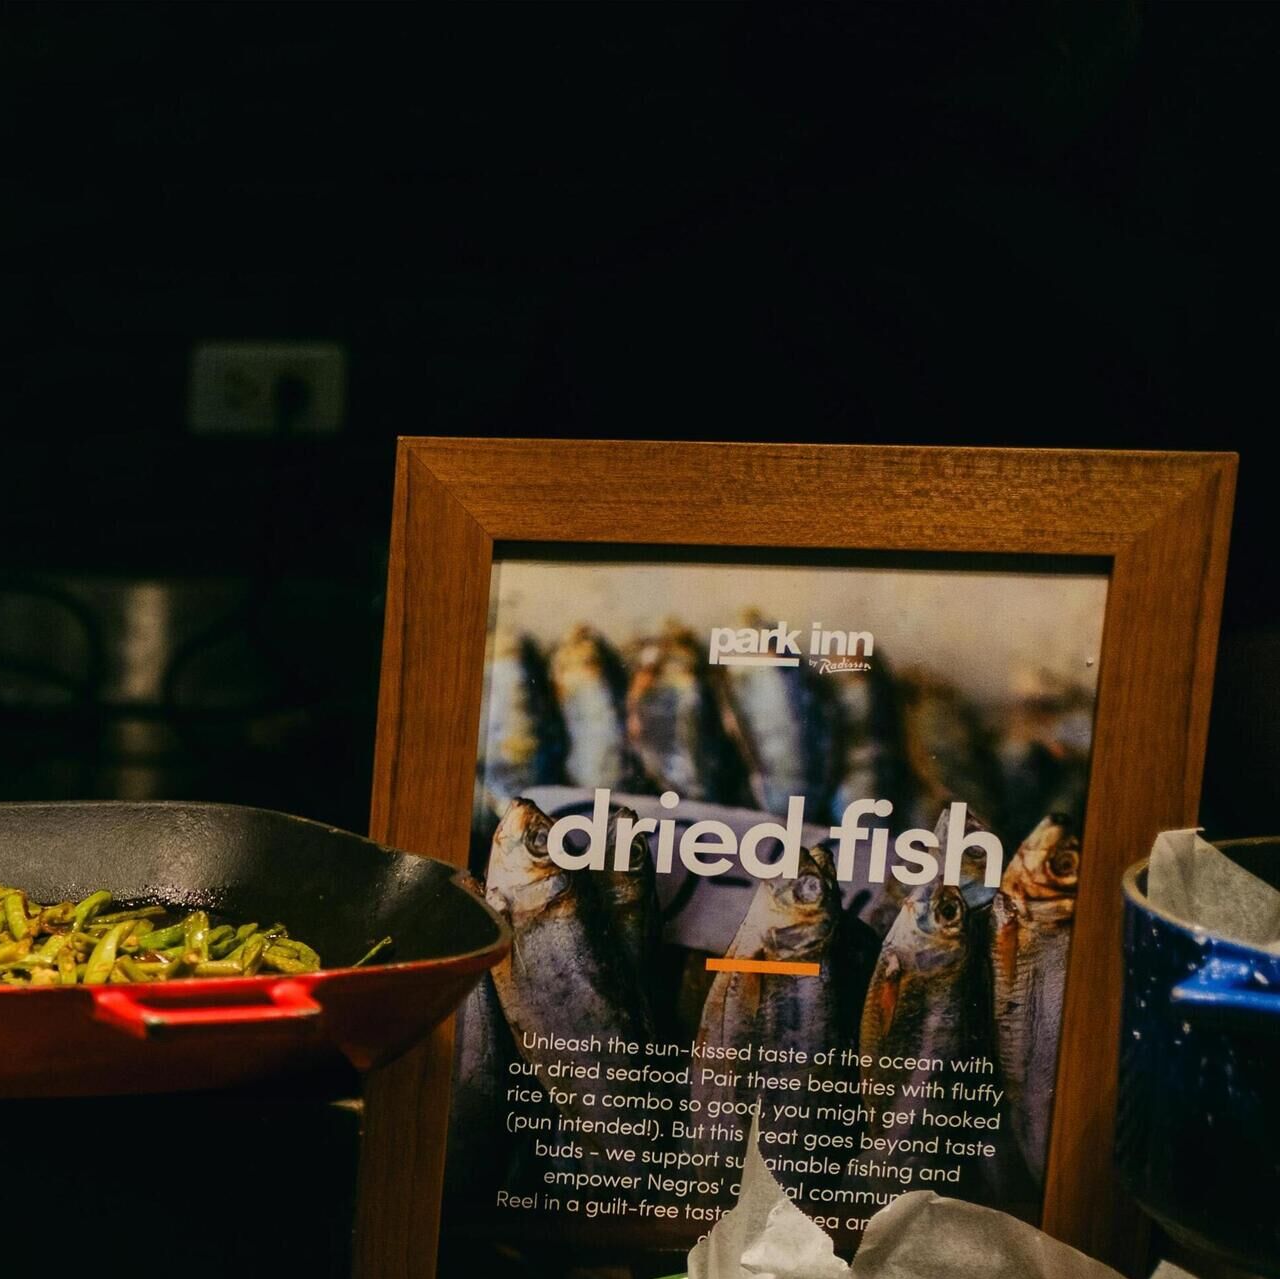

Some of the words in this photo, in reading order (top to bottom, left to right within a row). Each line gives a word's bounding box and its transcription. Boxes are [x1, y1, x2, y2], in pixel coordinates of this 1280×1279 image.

[708, 621, 802, 665] park
[810, 622, 874, 656] inn
[819, 657, 871, 675] Radisson
[546, 788, 805, 880] dried
[829, 798, 1004, 888] fish
[522, 1032, 601, 1053] Unleash
[607, 1036, 639, 1055] the
[645, 1040, 752, 1061] sun-kissed
[758, 1046, 807, 1064] taste
[814, 1048, 836, 1066] of
[841, 1050, 873, 1067] the
[879, 1057, 944, 1071] ocean
[950, 1056, 993, 1074] with
[509, 1062, 542, 1075] our
[548, 1061, 600, 1079] dried
[606, 1064, 693, 1085] seafood.
[701, 1069, 742, 1087] Pair
[747, 1071, 801, 1090] these
[807, 1074, 895, 1096] beauties
[902, 1081, 944, 1099] with
[952, 1082, 1004, 1107] fluffy
[506, 1085, 543, 1103] rice
[548, 1086, 576, 1105] for
[582, 1093, 595, 1106] a
[602, 1092, 673, 1110] combo
[679, 1099, 701, 1112] so
[707, 1098, 766, 1119] good,
[773, 1104, 810, 1121] you
[817, 1104, 876, 1126] might
[882, 1110, 916, 1128] get
[922, 1108, 1001, 1130] hooked
[506, 1112, 551, 1133] (pun
[558, 1114, 664, 1141] intended!).
[672, 1121, 704, 1139] But
[710, 1122, 744, 1141] this
[757, 1130, 798, 1145] reat
[804, 1133, 853, 1151] goes
[860, 1132, 938, 1155] beyond
[945, 1139, 995, 1157] taste
[536, 1139, 583, 1159] buds
[606, 1148, 635, 1161] we
[642, 1150, 719, 1170] support
[725, 1155, 841, 1174] suainable
[847, 1159, 912, 1183] fishing
[920, 1166, 960, 1182] and
[497, 1191, 538, 1208] Reel
[544, 1194, 560, 1210] in
[567, 1199, 579, 1212] a
[586, 1198, 679, 1218] guilt-free
[544, 1171, 642, 1190] empower
[648, 1174, 724, 1196] Negros'
